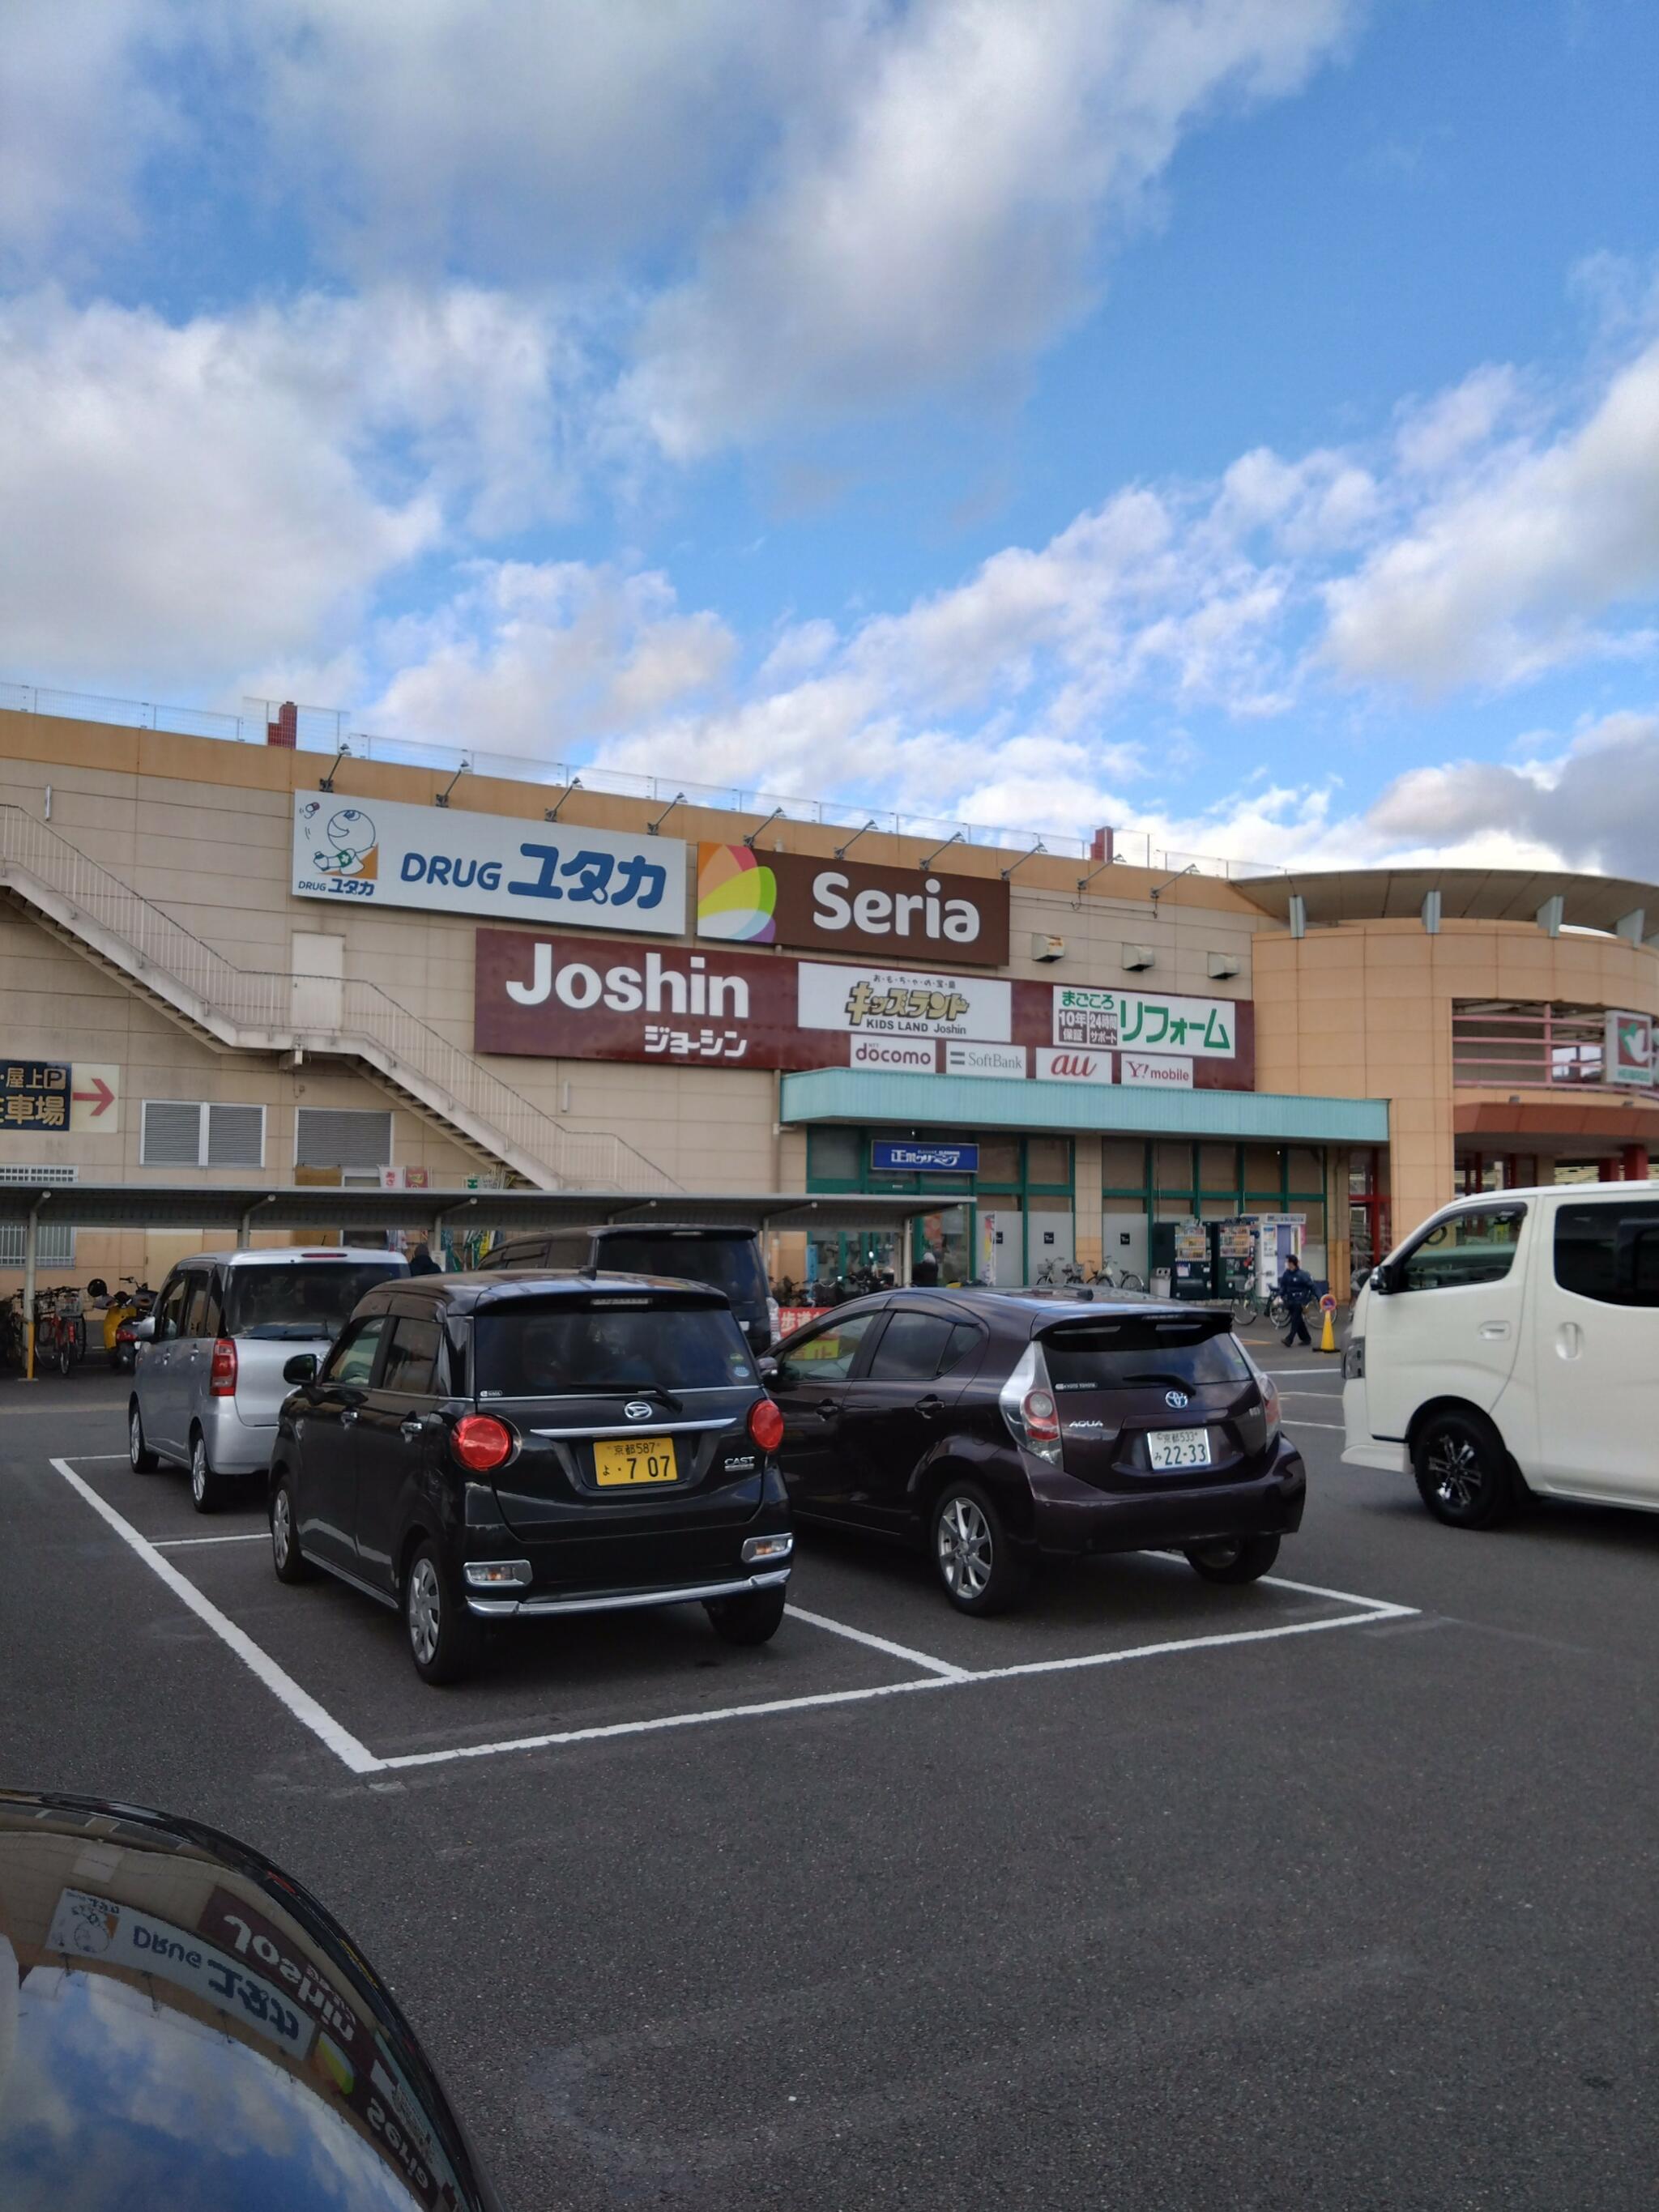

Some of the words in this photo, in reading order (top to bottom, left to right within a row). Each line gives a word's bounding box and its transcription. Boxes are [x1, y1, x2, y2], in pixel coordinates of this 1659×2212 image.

[298, 880, 326, 892] DRUG
[328, 878, 375, 896] ユタカ
[400, 852, 502, 891] DRUG
[507, 842, 667, 910] ユタカ
[812, 872, 980, 943] Seria
[505, 943, 749, 1019] Joshin
[845, 981, 970, 1025] キッズランド
[1061, 990, 1115, 1011] まごころ
[866, 1018, 894, 1030] KIDS
[898, 1021, 928, 1033] LAND
[933, 1023, 966, 1035] Joshin
[1059, 1011, 1087, 1028] 10年
[1120, 999, 1230, 1050] リフォーム
[644, 1025, 748, 1058] ジョーシン
[855, 1042, 932, 1065] docomo
[968, 1051, 1023, 1071] SoftBank
[1051, 1054, 1097, 1077] au
[0, 1094, 65, 1126] 車場
[1068, 1420, 1103, 1428] AQUA
[724, 1455, 755, 1465] CAST
